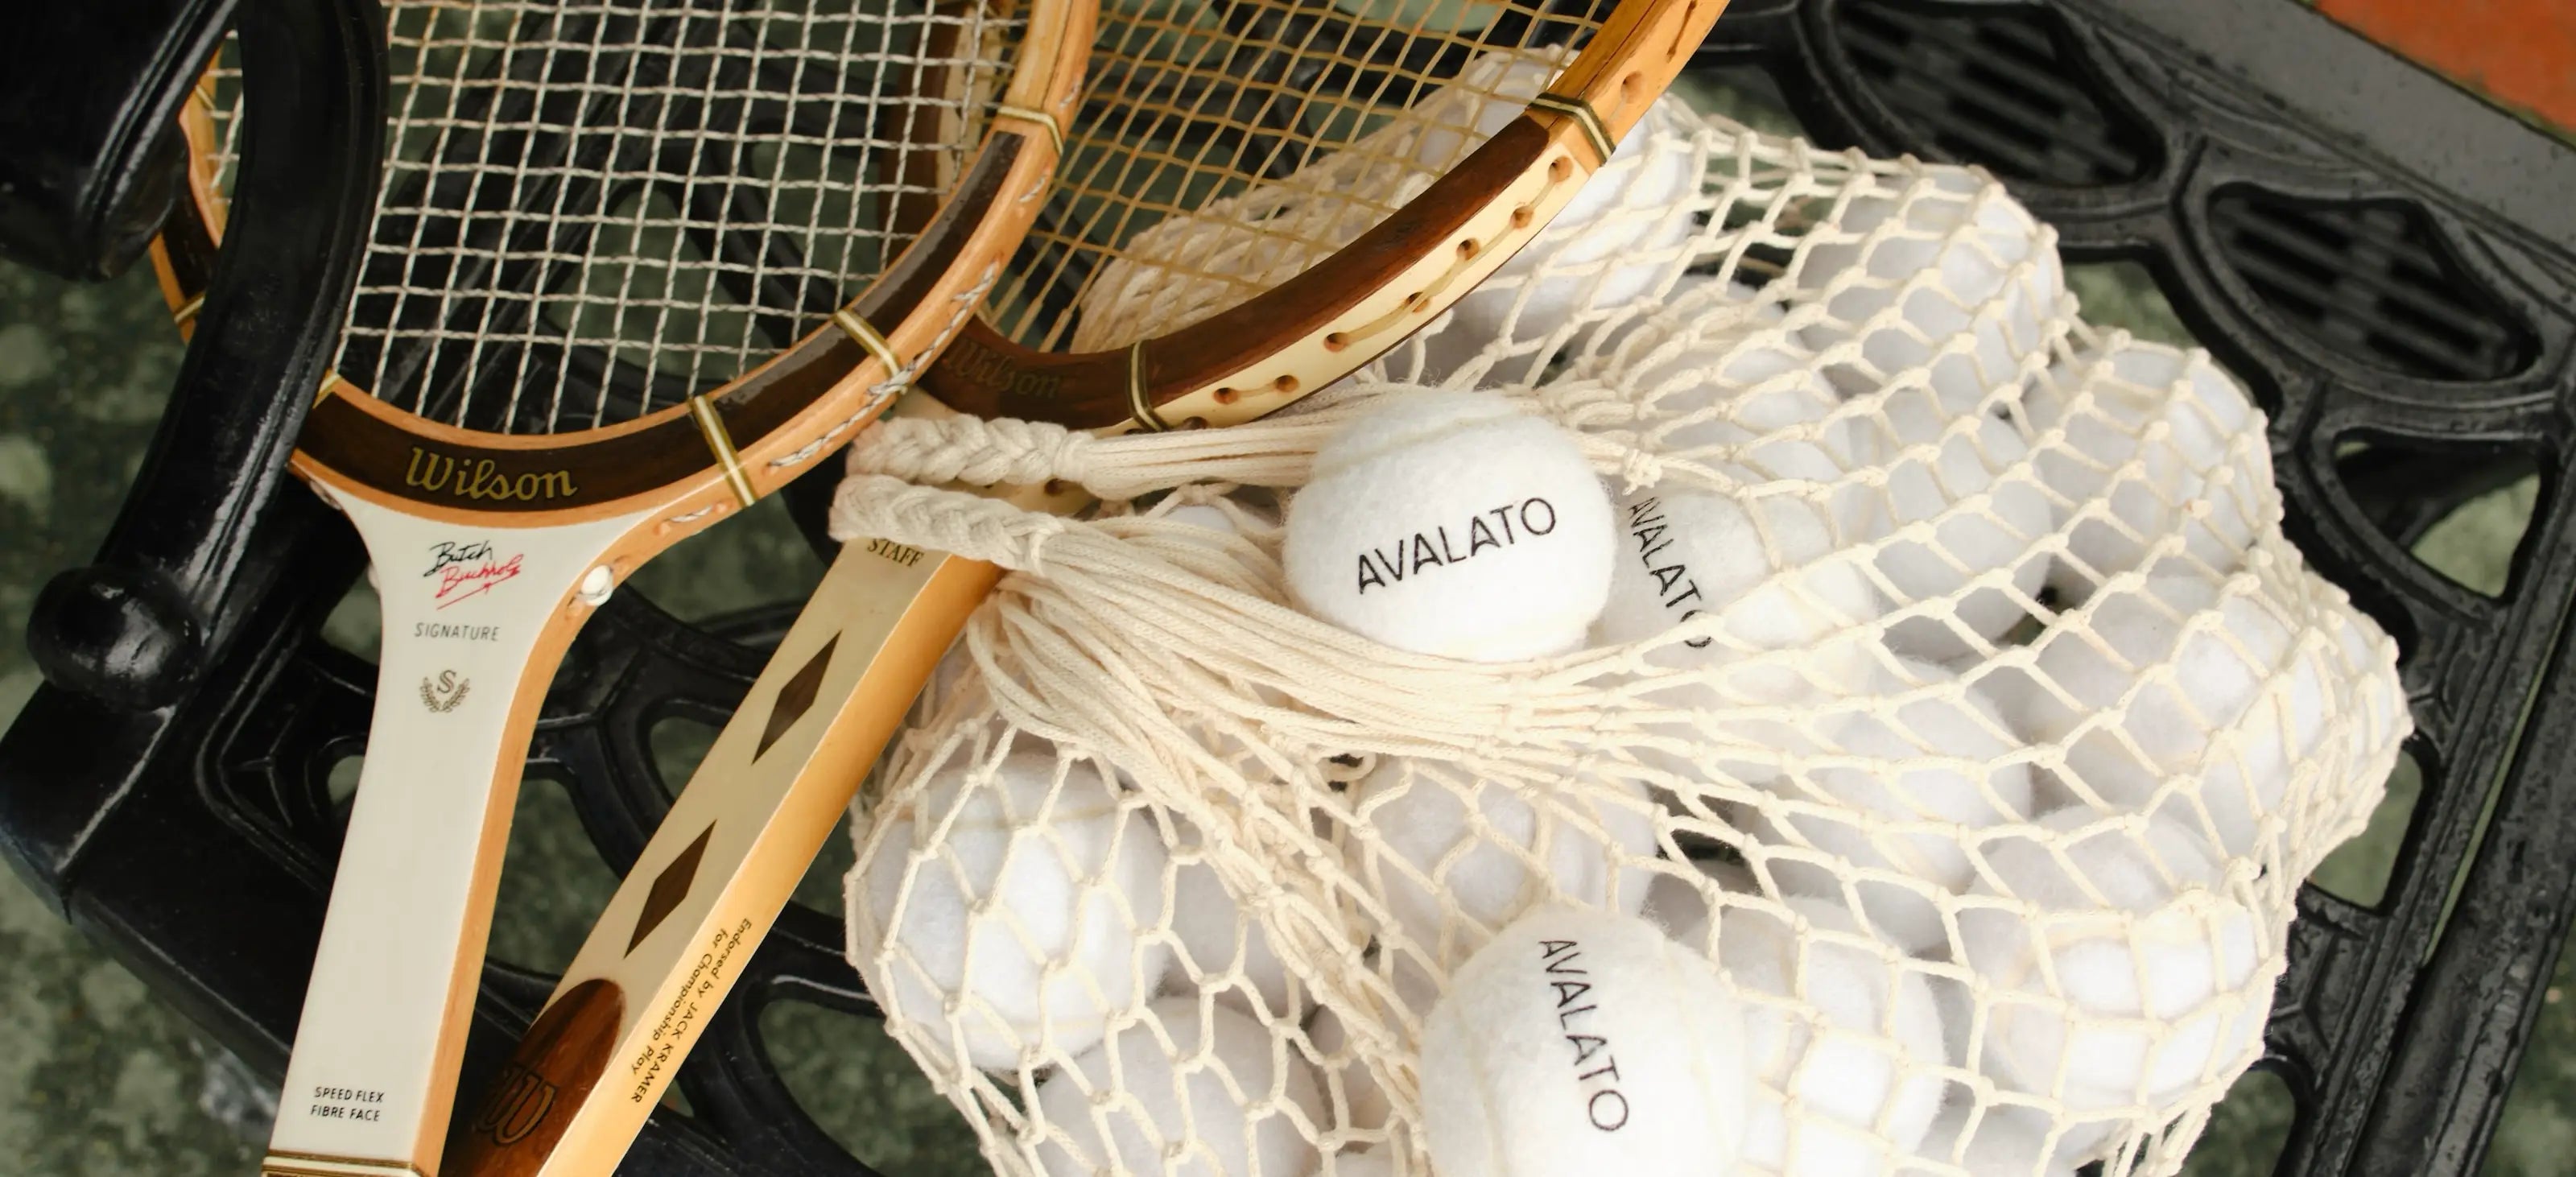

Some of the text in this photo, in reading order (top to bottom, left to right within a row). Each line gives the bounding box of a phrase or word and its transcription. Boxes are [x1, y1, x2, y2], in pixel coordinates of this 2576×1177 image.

[946, 340, 1063, 400] Wilson
[405, 447, 578, 501] Wilson
[423, 540, 493, 578] Butch
[867, 538, 925, 568] STAFF
[1357, 496, 1557, 595] AVALATO
[414, 622, 501, 642] SIGNATURE
[630, 918, 753, 1104] Endorsed by JACK KRAMER
[631, 927, 729, 1076] for Championship Play
[1538, 939, 1629, 1132] AVALATO
[310, 1105, 382, 1122] FIBRE FACE
[314, 1086, 385, 1104] SPEED FLEX
